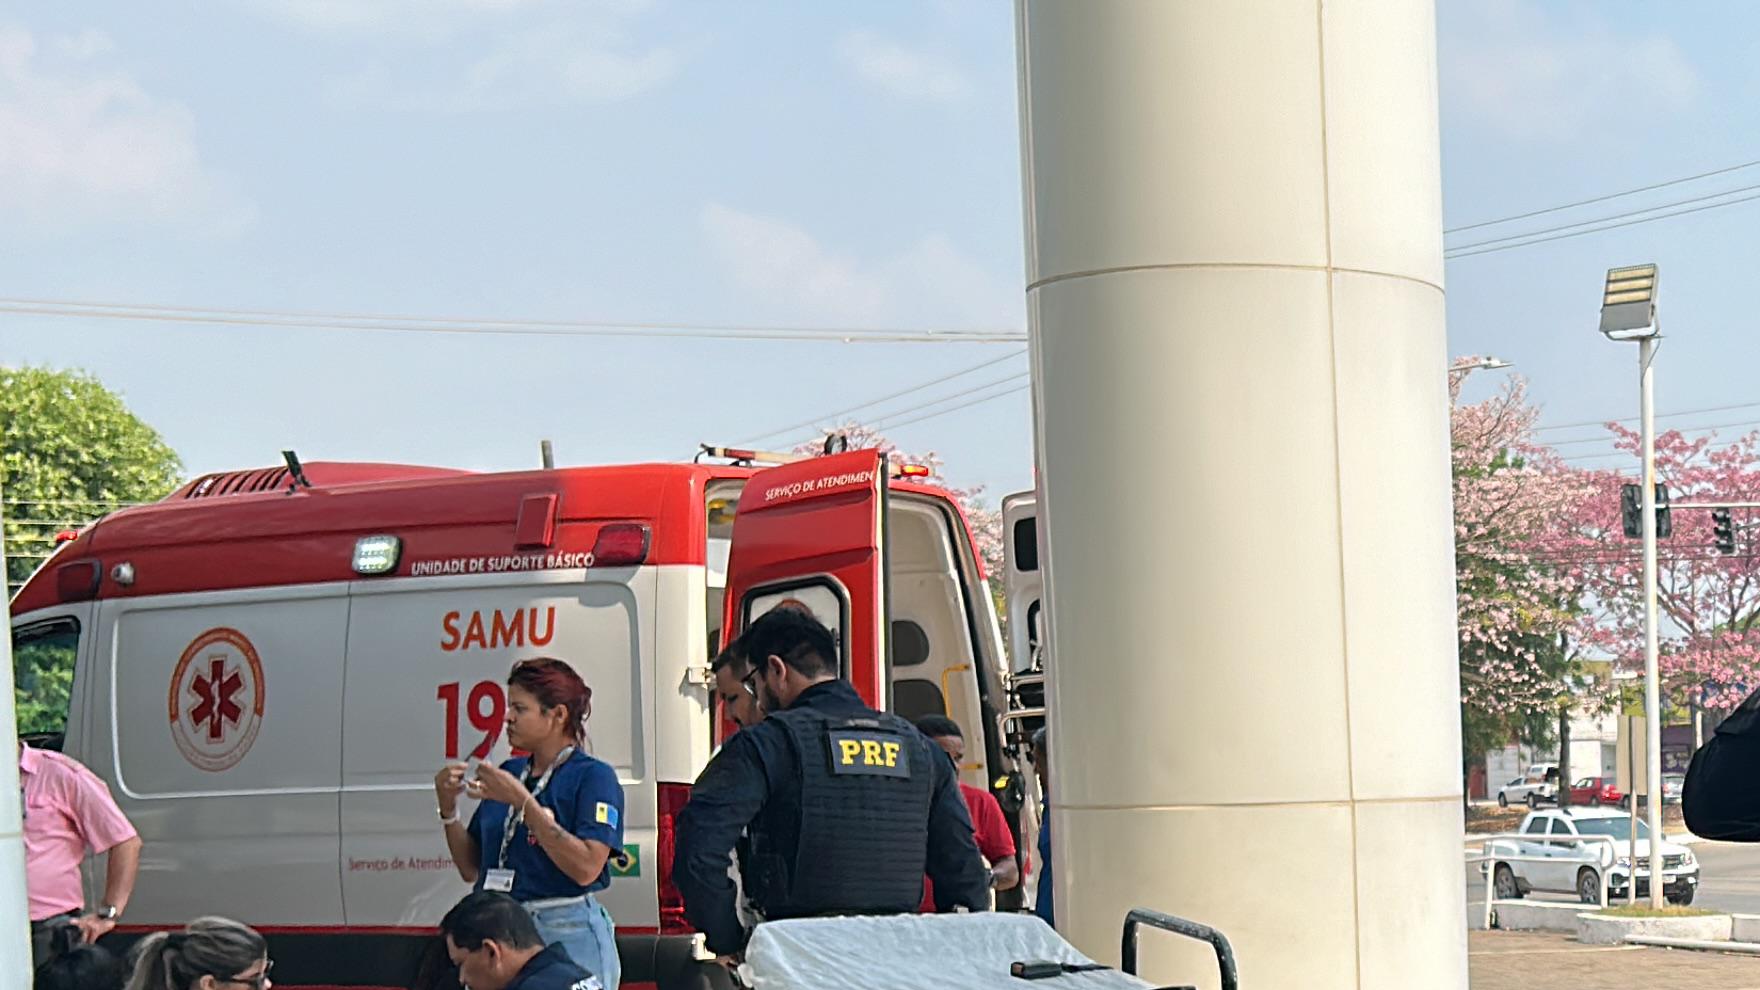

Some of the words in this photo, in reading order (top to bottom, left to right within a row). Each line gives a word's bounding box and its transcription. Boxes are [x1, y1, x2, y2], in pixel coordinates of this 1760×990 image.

[765, 483, 802, 501] SERVIÇO
[803, 480, 815, 492] DE
[411, 558, 467, 576] UNIDADE
[469, 556, 485, 572] DE
[487, 554, 545, 571] SUPORTE
[547, 549, 596, 568] BÁSICO
[440, 606, 556, 652] SAMU
[437, 680, 532, 760] 19
[838, 739, 900, 768] PRF
[349, 856, 389, 872] Serviço
[391, 855, 405, 870] de
